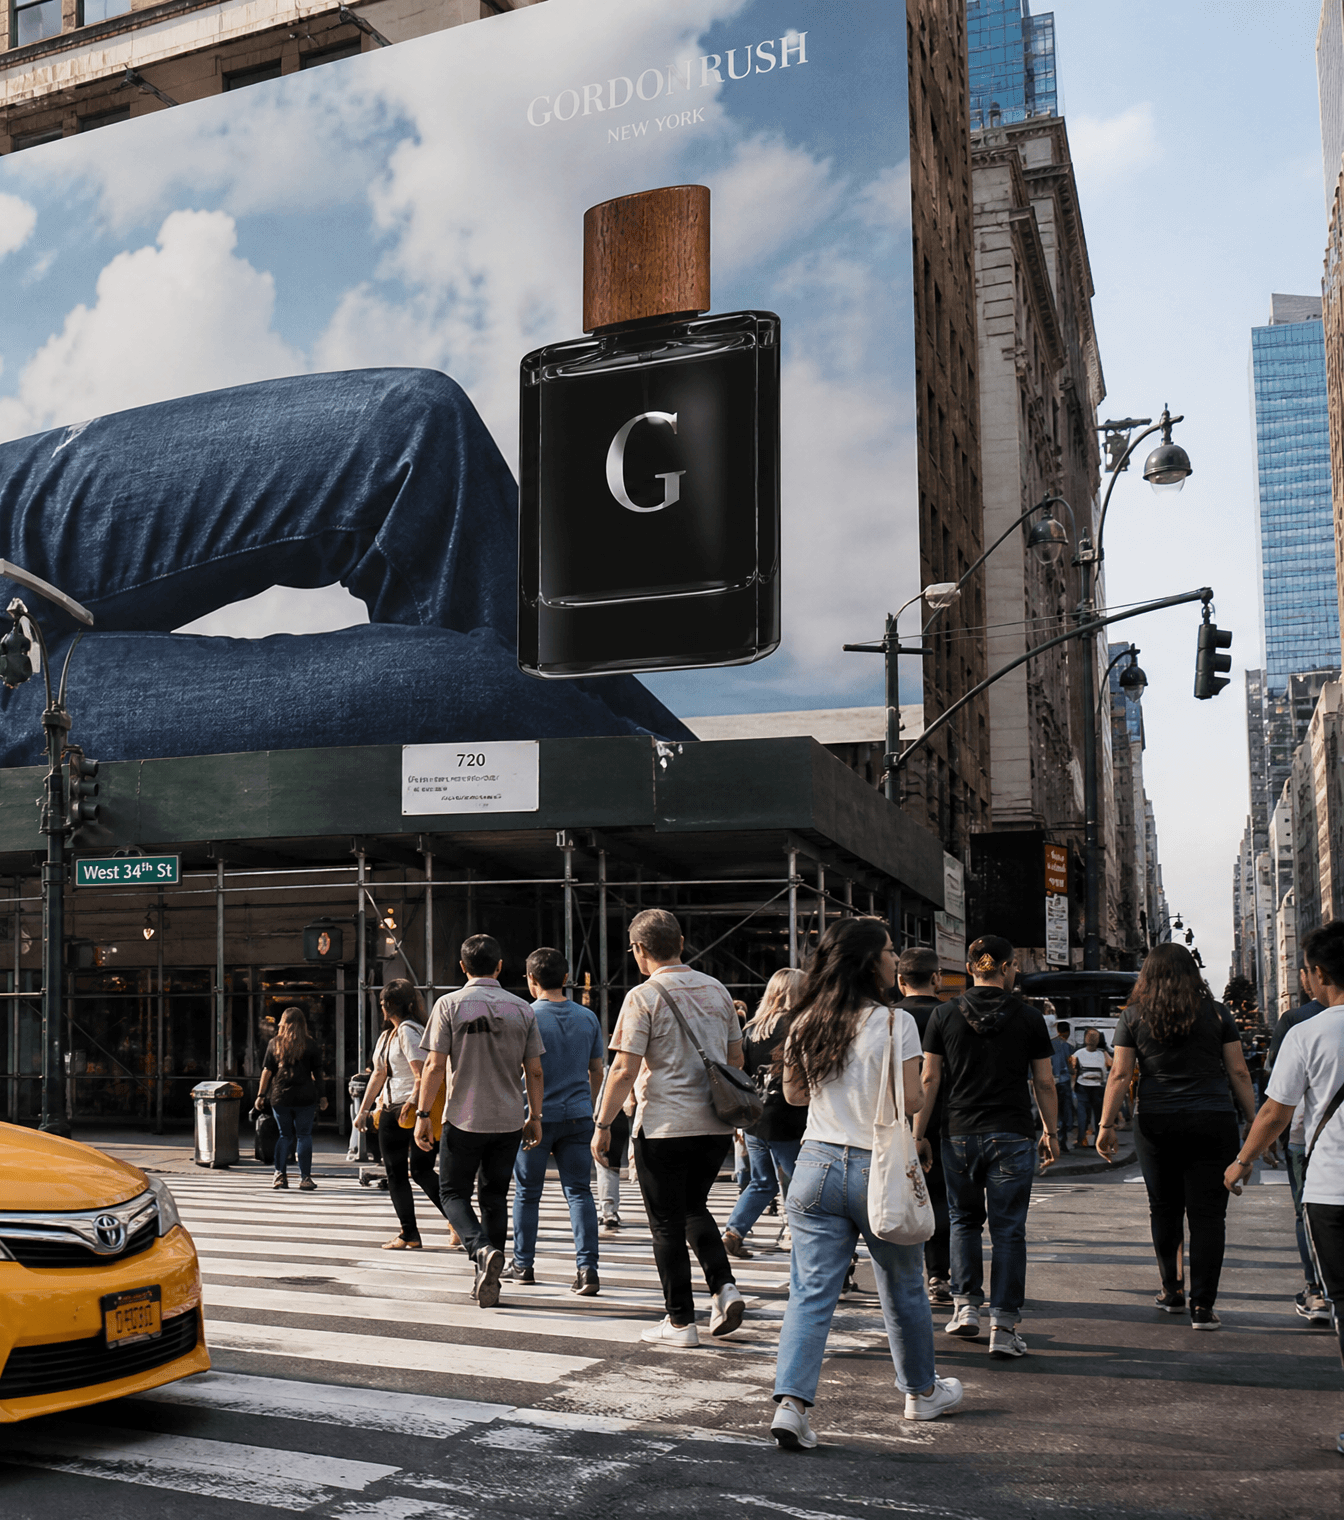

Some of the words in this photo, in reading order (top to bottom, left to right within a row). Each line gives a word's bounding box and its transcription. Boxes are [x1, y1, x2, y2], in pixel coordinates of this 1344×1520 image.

[527, 59, 693, 127] GORDON
[699, 31, 809, 88] RUSH
[607, 120, 650, 144] NEW
[655, 107, 705, 132] YORK
[606, 411, 687, 513] G
[456, 753, 486, 767] 720
[83, 865, 120, 880] West
[123, 862, 153, 879] 34th
[157, 863, 173, 878] St
